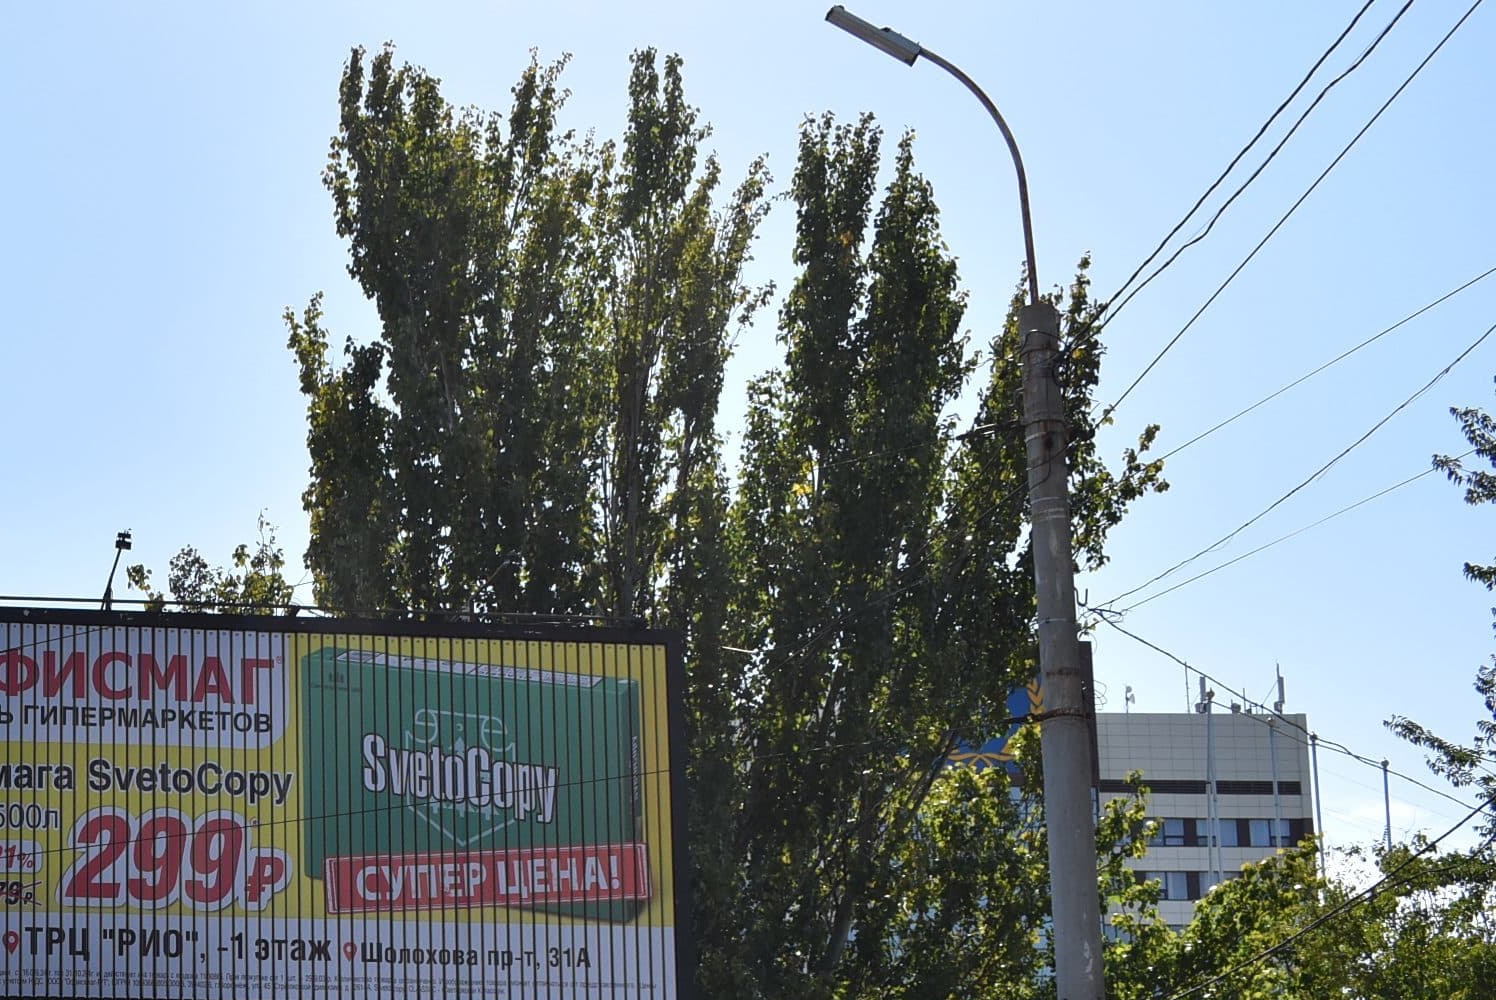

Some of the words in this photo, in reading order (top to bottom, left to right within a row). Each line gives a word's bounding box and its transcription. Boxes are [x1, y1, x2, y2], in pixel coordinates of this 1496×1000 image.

[23, 704, 272, 733] ГИПЕРМАРКЕТОВ
[89, 758, 294, 803] SvetoCopy
[362, 732, 559, 824] SvetoCopy
[356, 862, 488, 902] СУПЕР
[496, 854, 622, 899] ЦЕНА!
[24, 926, 91, 962] ТРЦ
[254, 936, 332, 963] этаж
[361, 941, 479, 967] Шолохова
